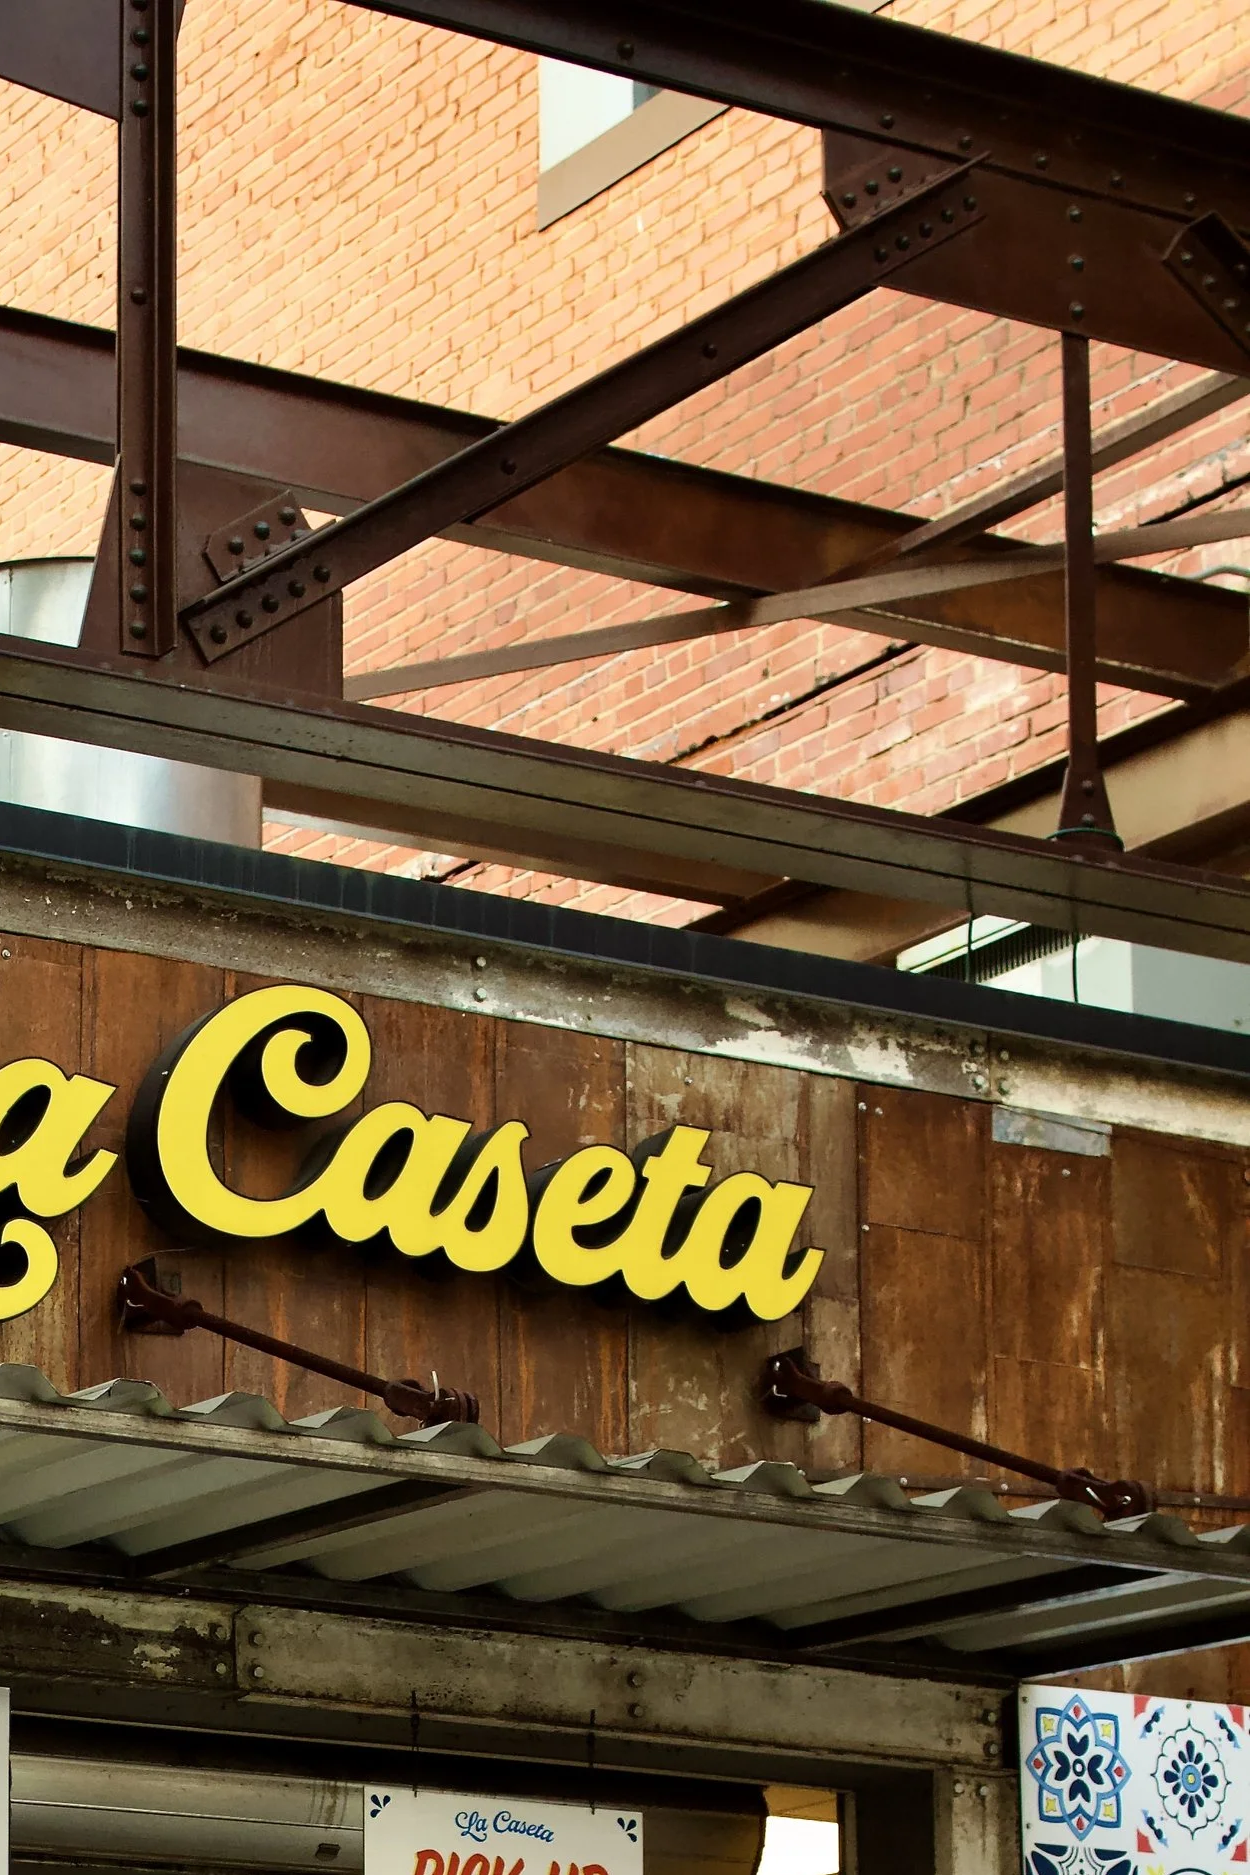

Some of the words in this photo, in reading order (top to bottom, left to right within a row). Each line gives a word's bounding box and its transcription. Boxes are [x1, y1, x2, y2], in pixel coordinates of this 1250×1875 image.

[154, 982, 828, 1324] Caseta
[454, 1811, 489, 1843] La
[492, 1810, 557, 1843] Caseta
